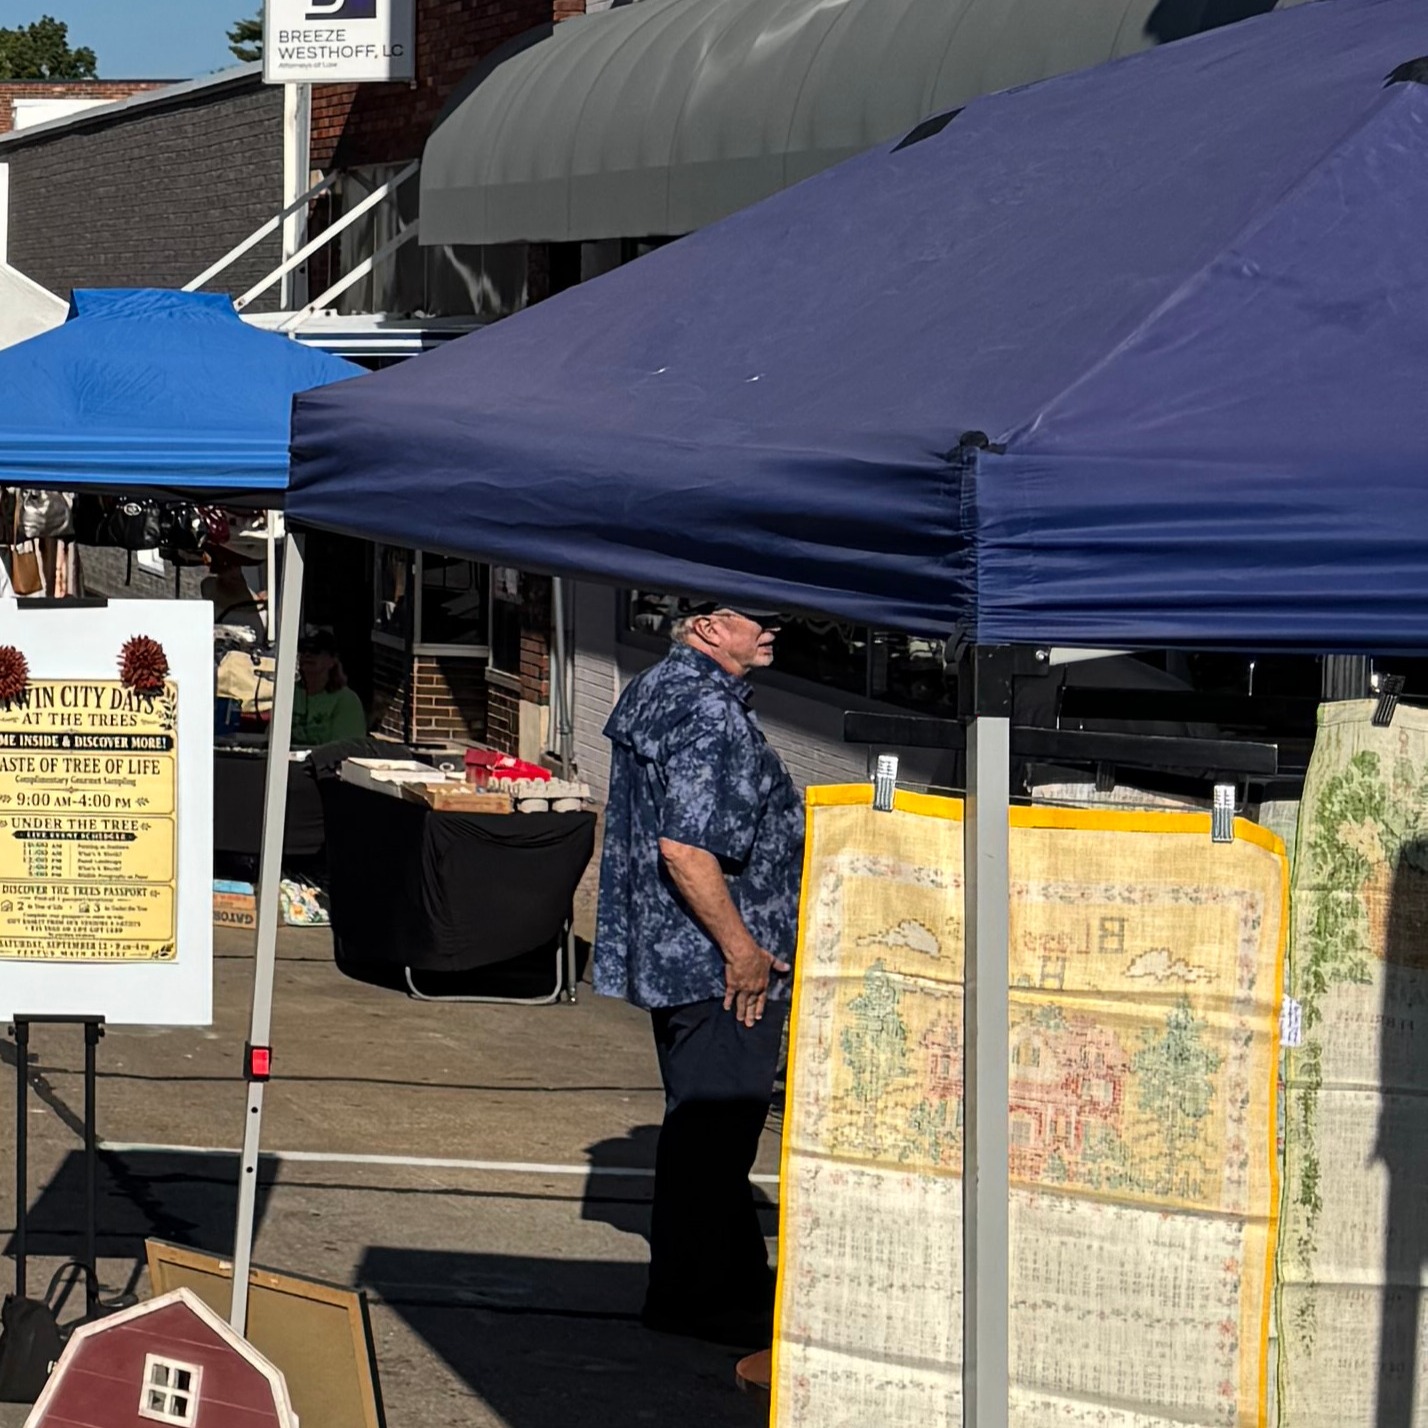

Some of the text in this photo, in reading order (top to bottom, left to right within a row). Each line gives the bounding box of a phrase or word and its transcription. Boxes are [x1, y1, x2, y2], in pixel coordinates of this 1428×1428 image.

[279, 29, 347, 43] BREEZE
[278, 44, 404, 59] WESTHOFF, LC
[60, 686, 106, 710] CITY
[110, 688, 154, 715] DAYS
[22, 713, 138, 727] AT THE TREES
[20, 735, 59, 748] INSIDE
[62, 736, 71, 748] &
[74, 736, 128, 749] DISCOVER
[131, 737, 167, 750] MORE!
[40, 757, 58, 773] OF
[63, 758, 101, 774] TREE
[105, 759, 124, 774] OF
[129, 759, 160, 775] LIFE
[15, 775, 69, 785] Complimentary
[17, 793, 51, 807] 9:00
[115, 797, 131, 809] PM
[12, 817, 139, 831] UNDER THE TREE
[2, 884, 148, 897] DISCOVER THE TREES PASSPORT
[17, 901, 24, 911] 2
[93, 903, 101, 913] 3
